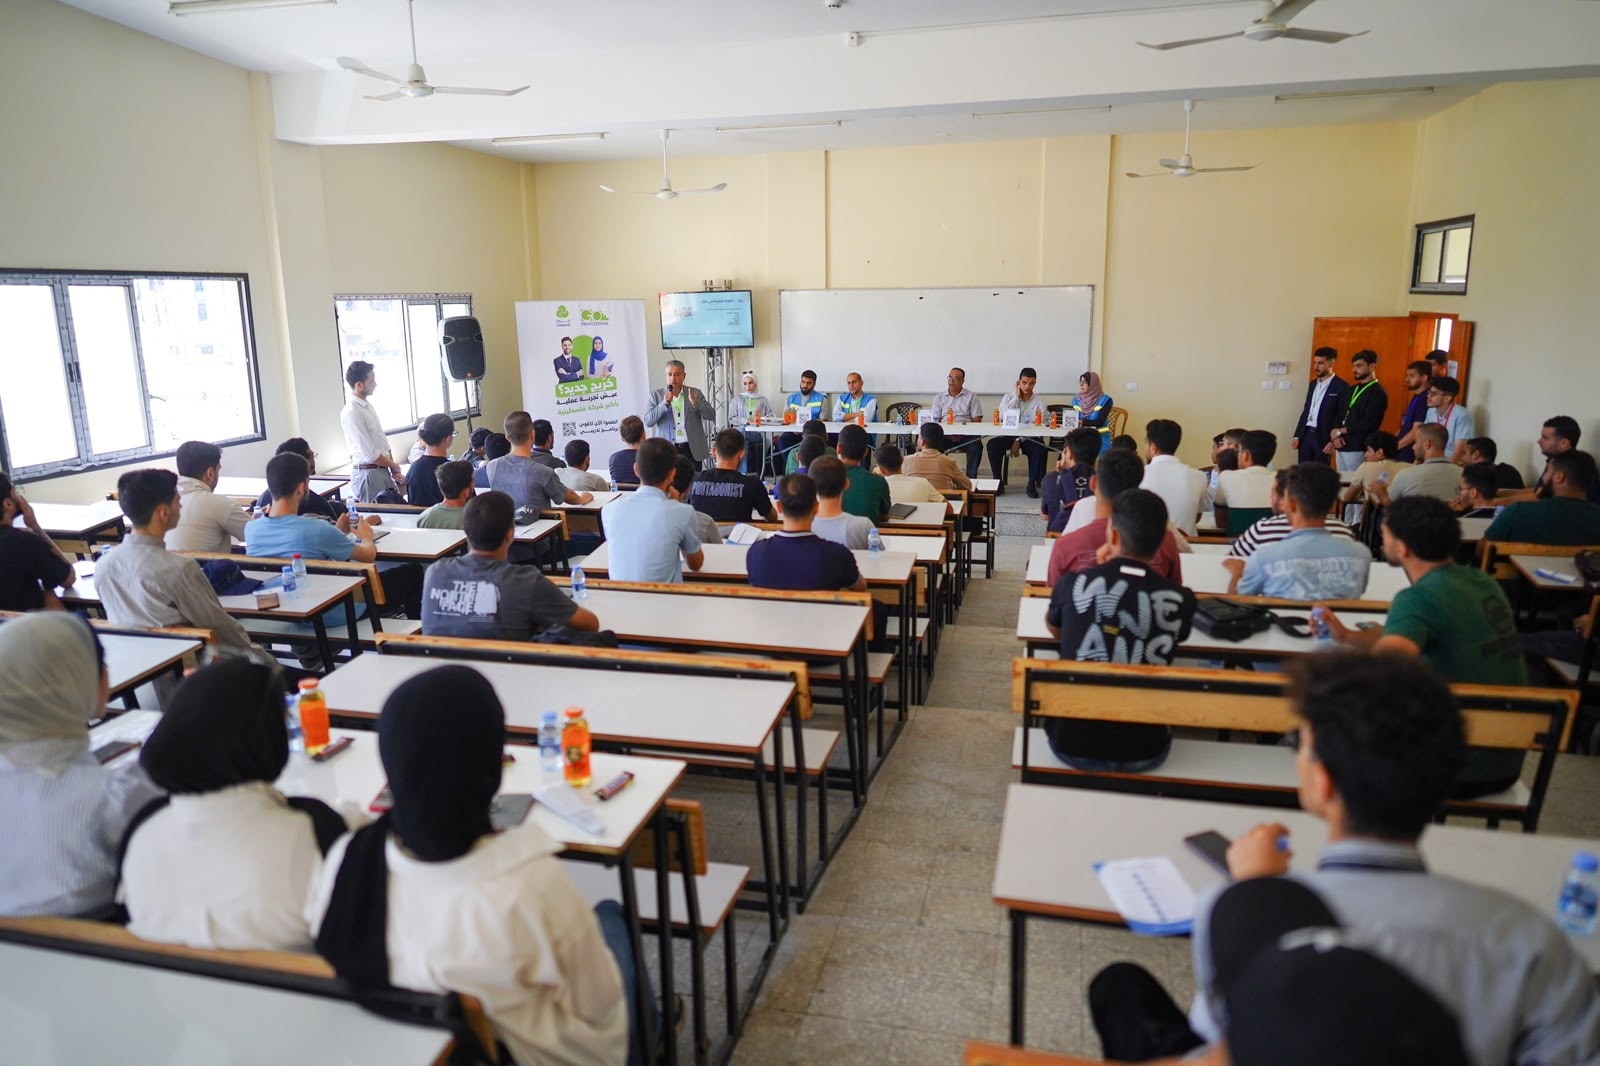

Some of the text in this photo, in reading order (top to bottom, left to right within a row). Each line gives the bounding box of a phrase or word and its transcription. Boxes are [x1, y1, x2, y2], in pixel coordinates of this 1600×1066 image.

[691, 480, 745, 498] PROTAGONIST
[452, 580, 477, 592] THE
[430, 587, 476, 603] NORTH
[439, 599, 473, 615] FACE
